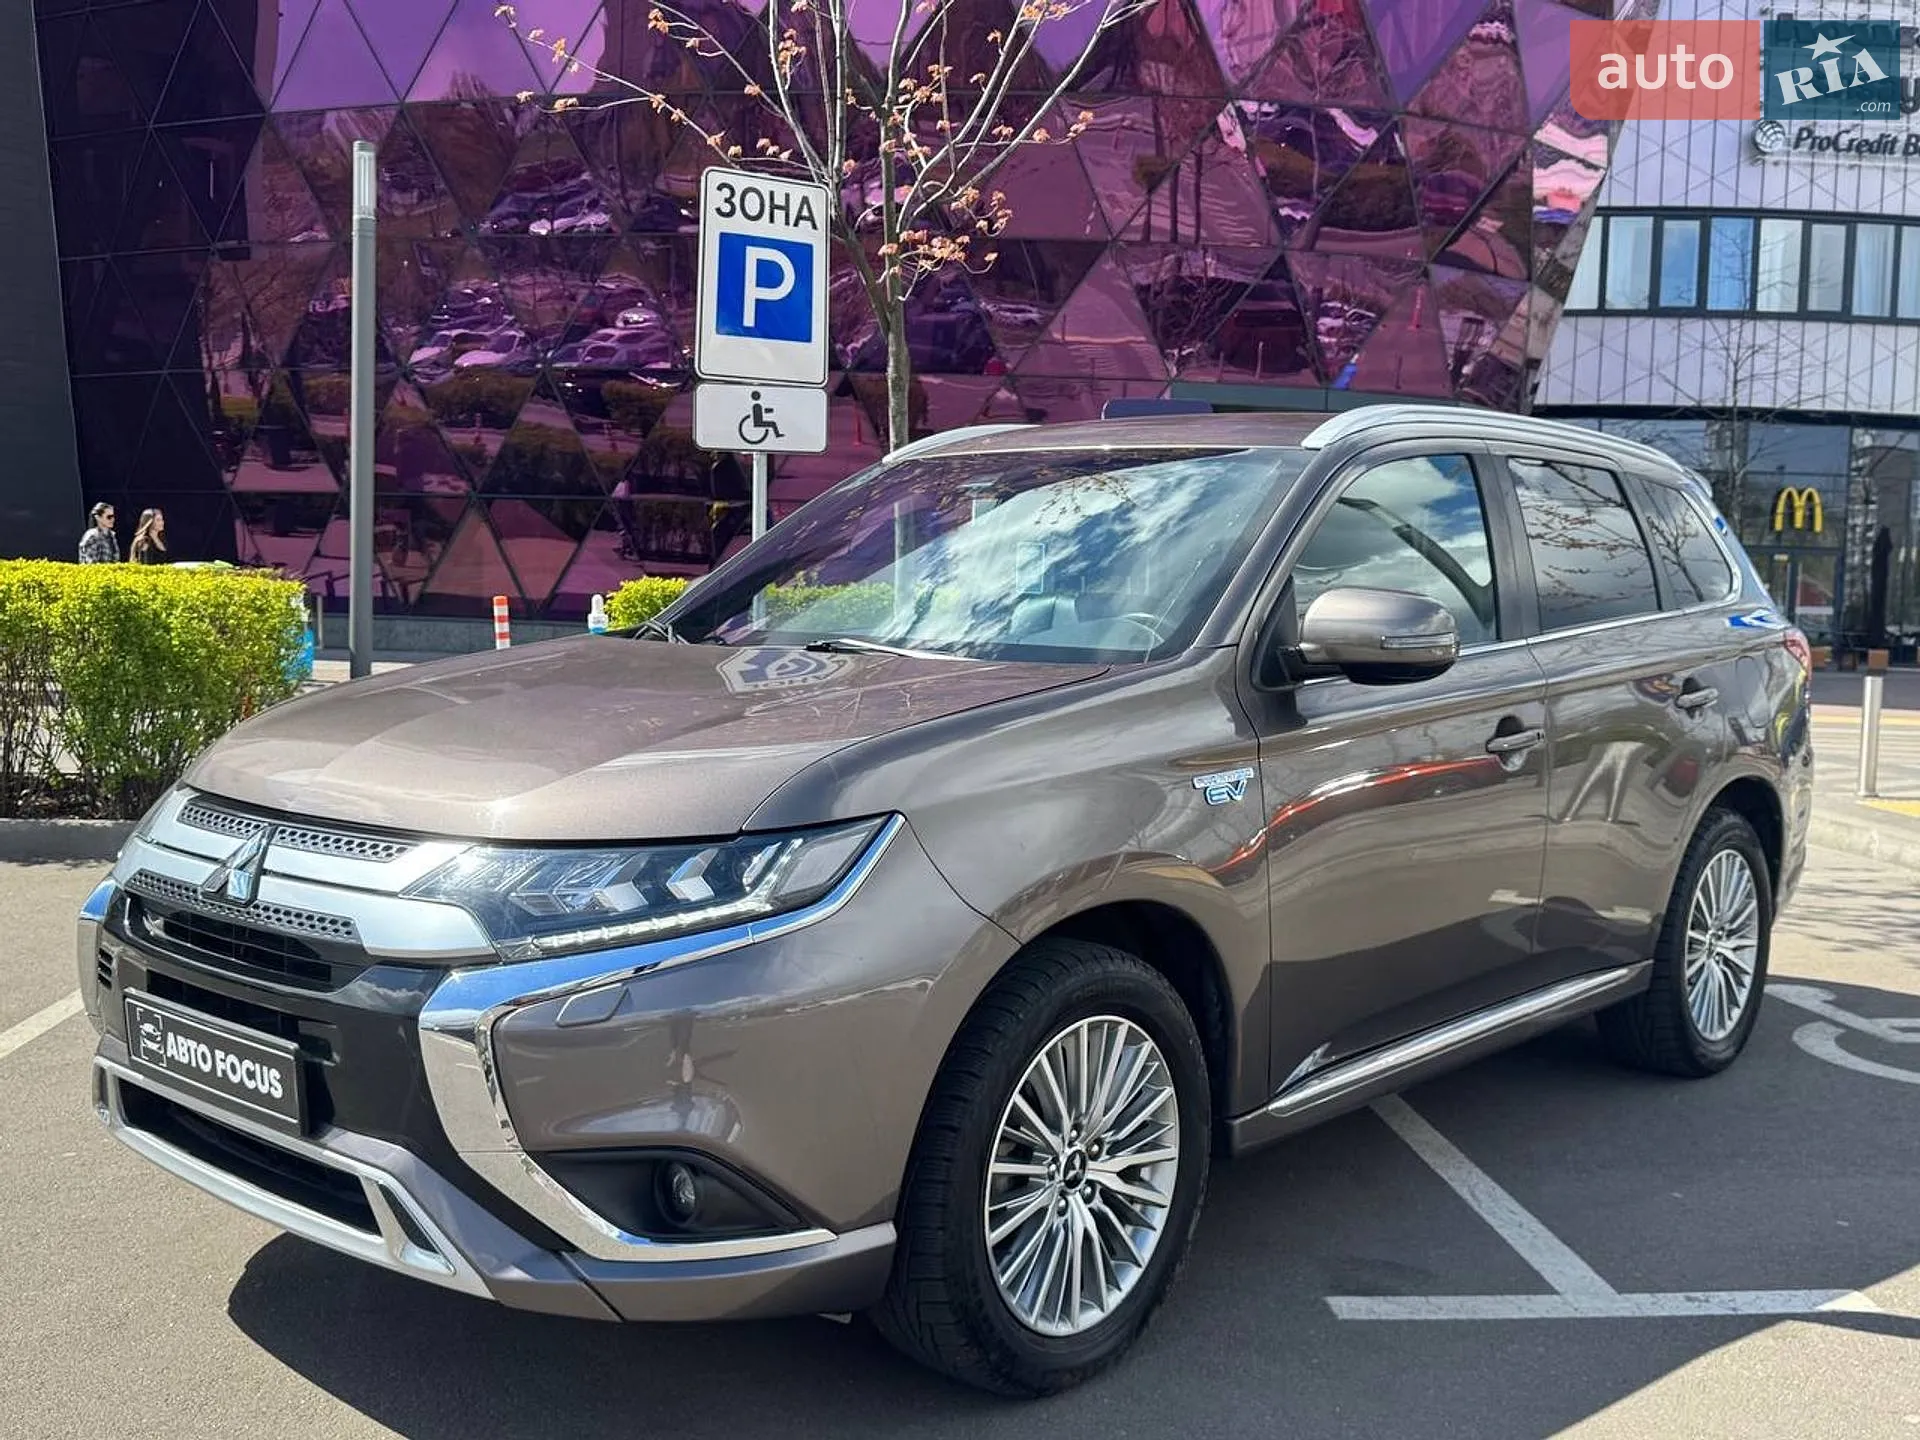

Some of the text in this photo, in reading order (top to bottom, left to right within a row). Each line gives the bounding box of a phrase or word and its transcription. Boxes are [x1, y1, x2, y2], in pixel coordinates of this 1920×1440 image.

[1793, 126, 1898, 156] ProCredit
[715, 182, 818, 231] ЗОНА
[743, 246, 796, 328] P
[1204, 778, 1248, 806] EV
[214, 1049, 284, 1099] FOCUS
